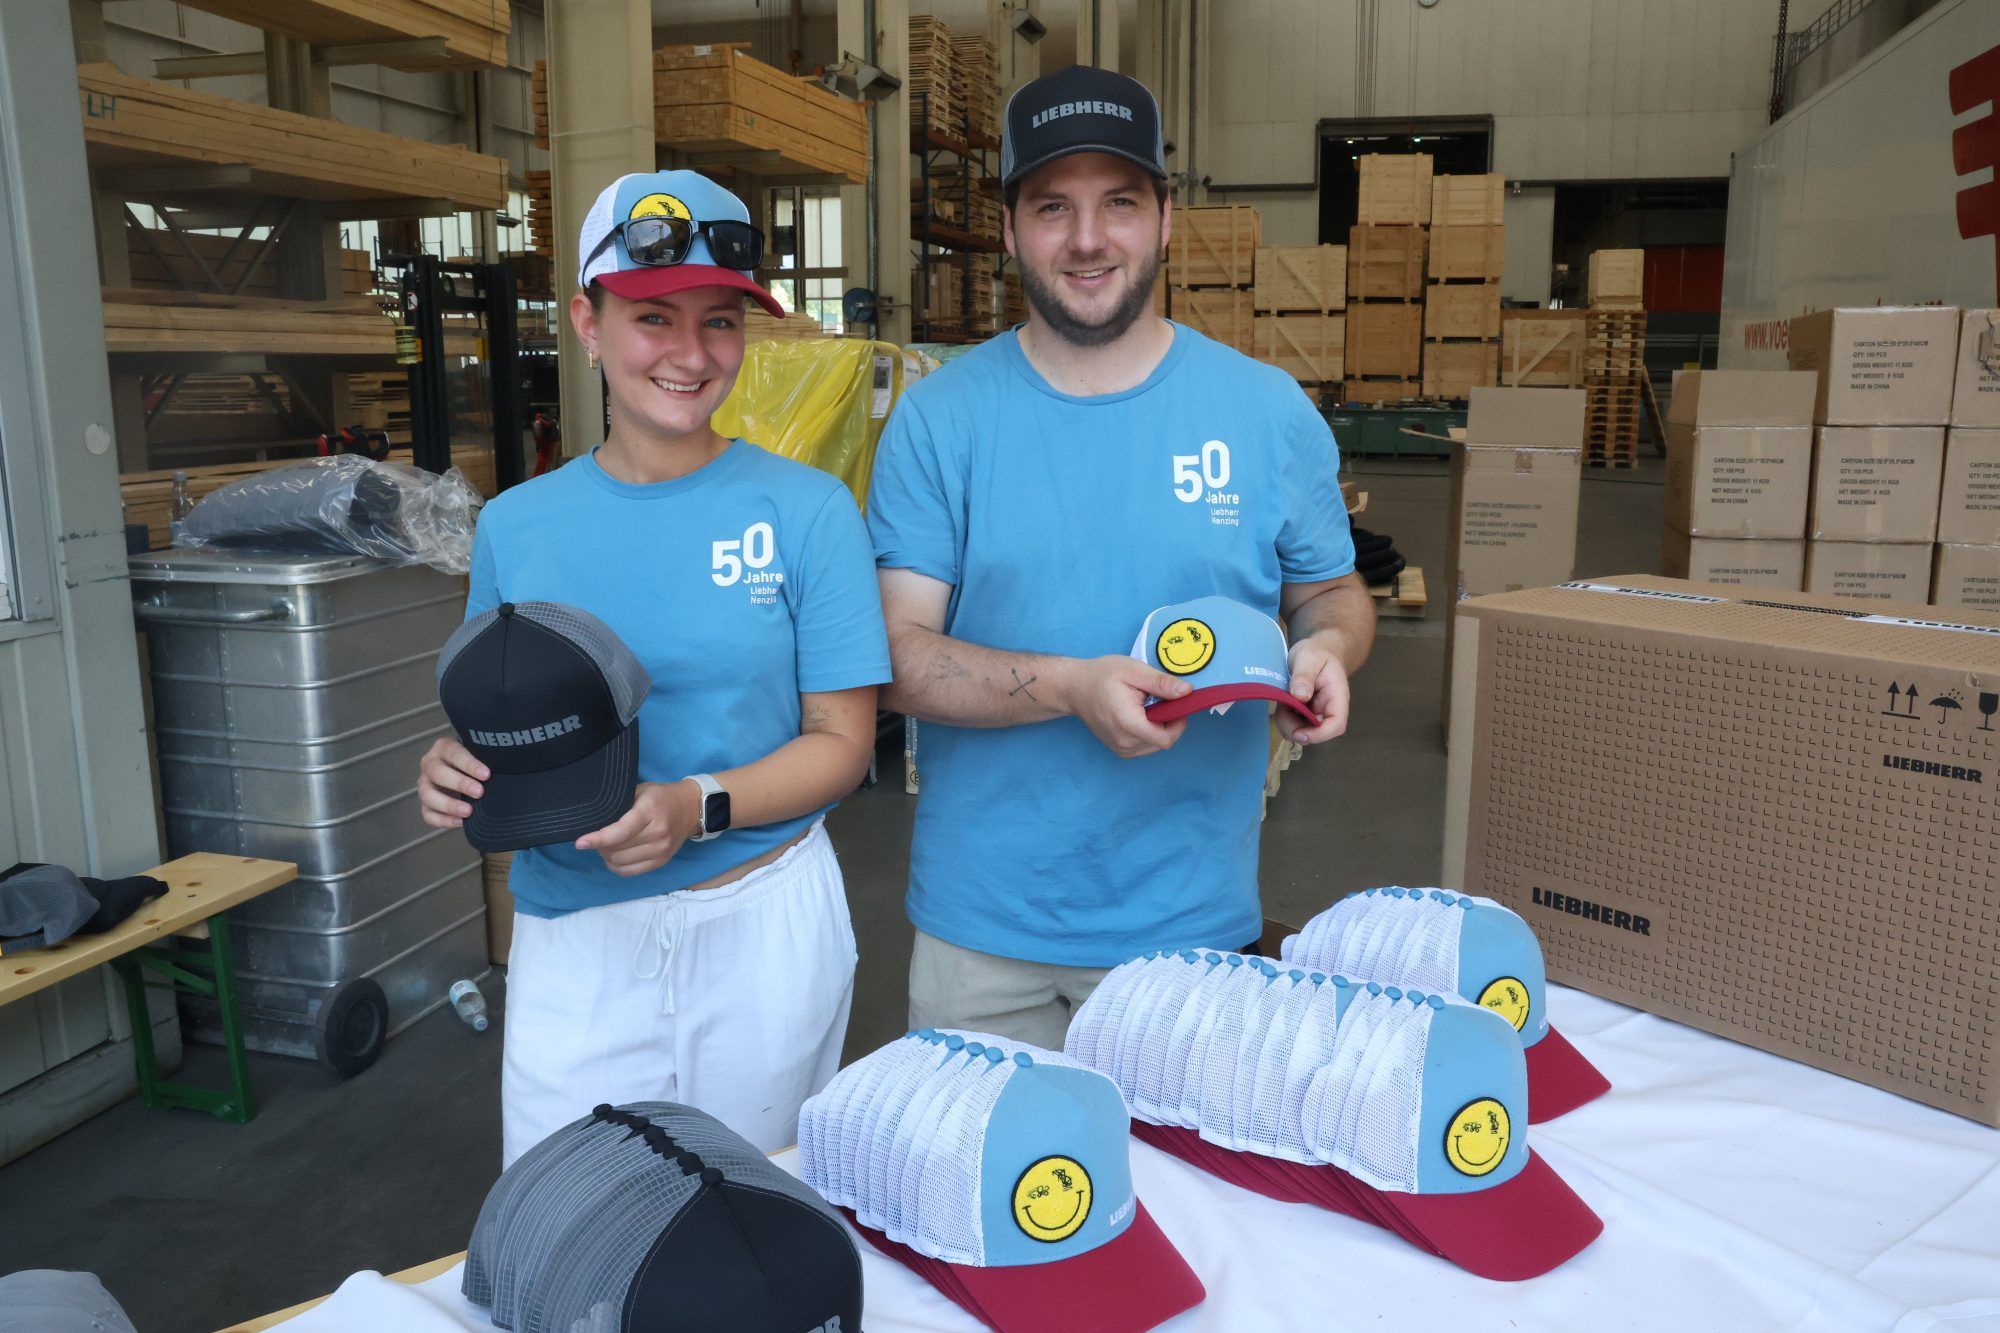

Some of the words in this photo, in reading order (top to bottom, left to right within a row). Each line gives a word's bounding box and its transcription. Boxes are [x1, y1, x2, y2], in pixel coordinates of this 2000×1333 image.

[87, 93, 116, 121] LH
[1032, 100, 1133, 128] LIEBHERR
[1173, 439, 1230, 503] 50
[1205, 491, 1240, 504] Jahre
[711, 521, 774, 587] 50
[743, 571, 784, 584] Jahre
[750, 586, 778, 595] Liebhe
[468, 714, 582, 747] LIEBHERR
[1883, 754, 1982, 784] LIEBHERR
[1532, 887, 1651, 936] LIEBHERR
